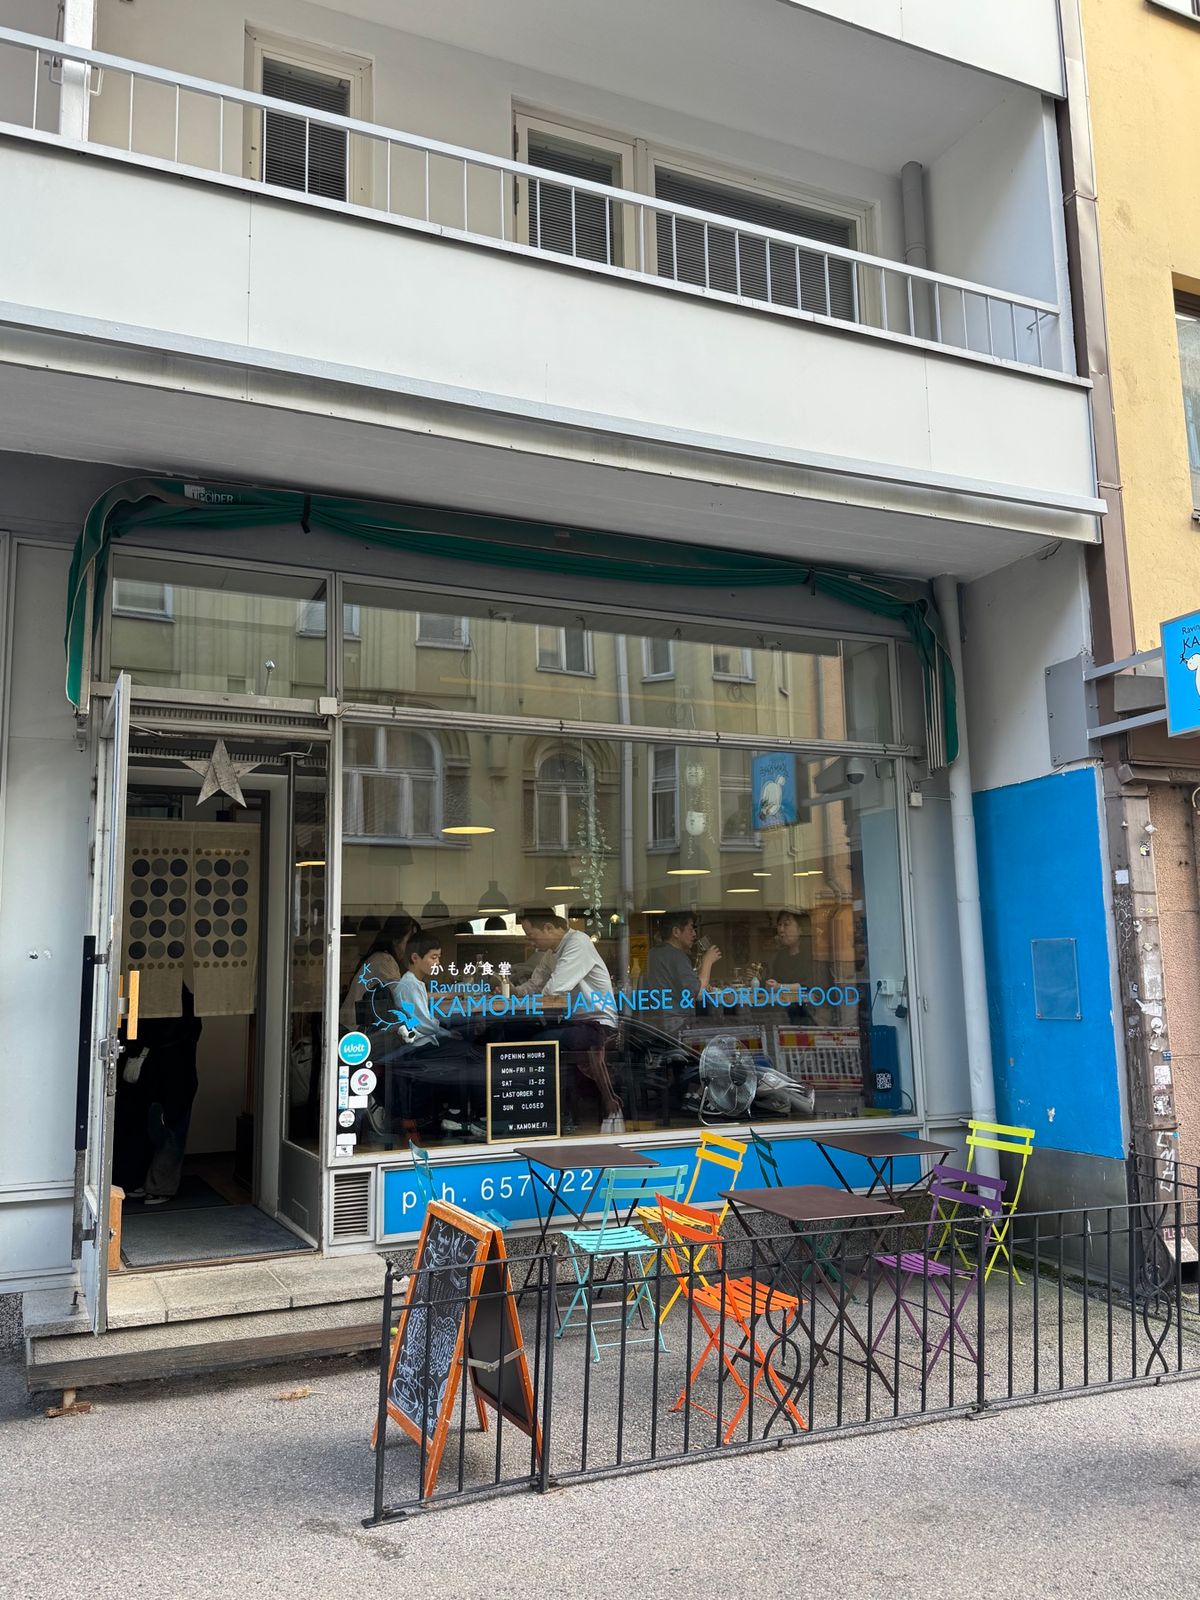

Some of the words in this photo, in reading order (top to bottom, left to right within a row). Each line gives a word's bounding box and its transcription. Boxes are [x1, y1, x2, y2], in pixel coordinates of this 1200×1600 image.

[430, 961, 512, 976] かもめ食堂
[430, 979, 491, 993] Ravintola
[430, 993, 544, 1018] KAMOME
[563, 988, 673, 1020] JAPANESE
[680, 988, 695, 1009] &
[702, 987, 791, 1009] NORDIC
[798, 986, 860, 1007] FOOD
[344, 1044, 365, 1053] Wolt
[501, 1066, 526, 1074] MON-FRI
[481, 1175, 531, 1200] 657
[543, 1169, 594, 1193] 422
